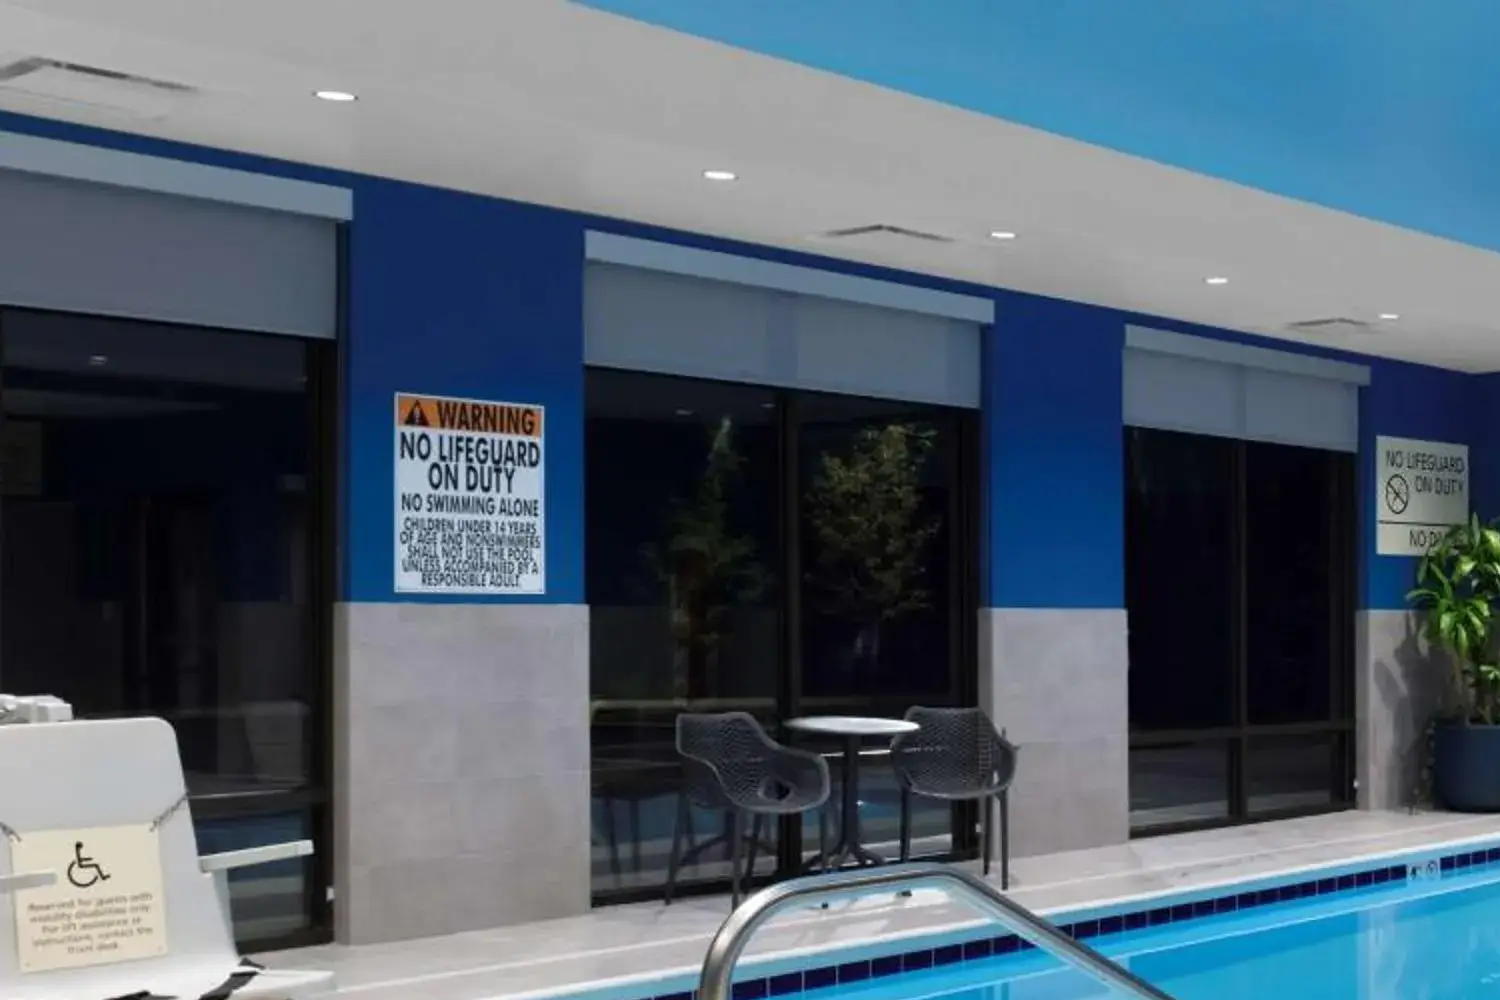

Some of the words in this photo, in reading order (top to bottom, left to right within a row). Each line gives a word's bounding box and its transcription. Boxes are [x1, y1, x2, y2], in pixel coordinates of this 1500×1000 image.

[436, 400, 534, 435] WARNING
[400, 432, 431, 460] NO
[439, 435, 541, 467] LIFEGUARD
[1386, 450, 1403, 468] NO
[1407, 452, 1465, 473] LIFEGUARD
[429, 463, 458, 490] ON
[466, 466, 515, 493] DUTY
[1415, 476, 1433, 493] ON
[1435, 477, 1464, 496] DUTY
[401, 493, 422, 511] NO
[426, 495, 495, 516] SWIMMING
[499, 499, 539, 517] ALONE
[404, 517, 454, 532] CHILDREN
[457, 519, 491, 533] UNDER
[495, 520, 506, 532] 14
[508, 521, 536, 534] YEARS
[400, 531, 414, 544] OF
[417, 531, 437, 545] AGE
[441, 532, 462, 545] AND
[1409, 529, 1427, 547] NO
[408, 545, 439, 559] SHALL
[441, 545, 462, 559] NOT
[466, 547, 484, 560] USE
[487, 547, 504, 560] THE
[508, 547, 534, 561] POOL
[402, 558, 440, 572] UNLESS
[531, 561, 539, 575] A
[422, 573, 486, 587] RESPONSIBLE
